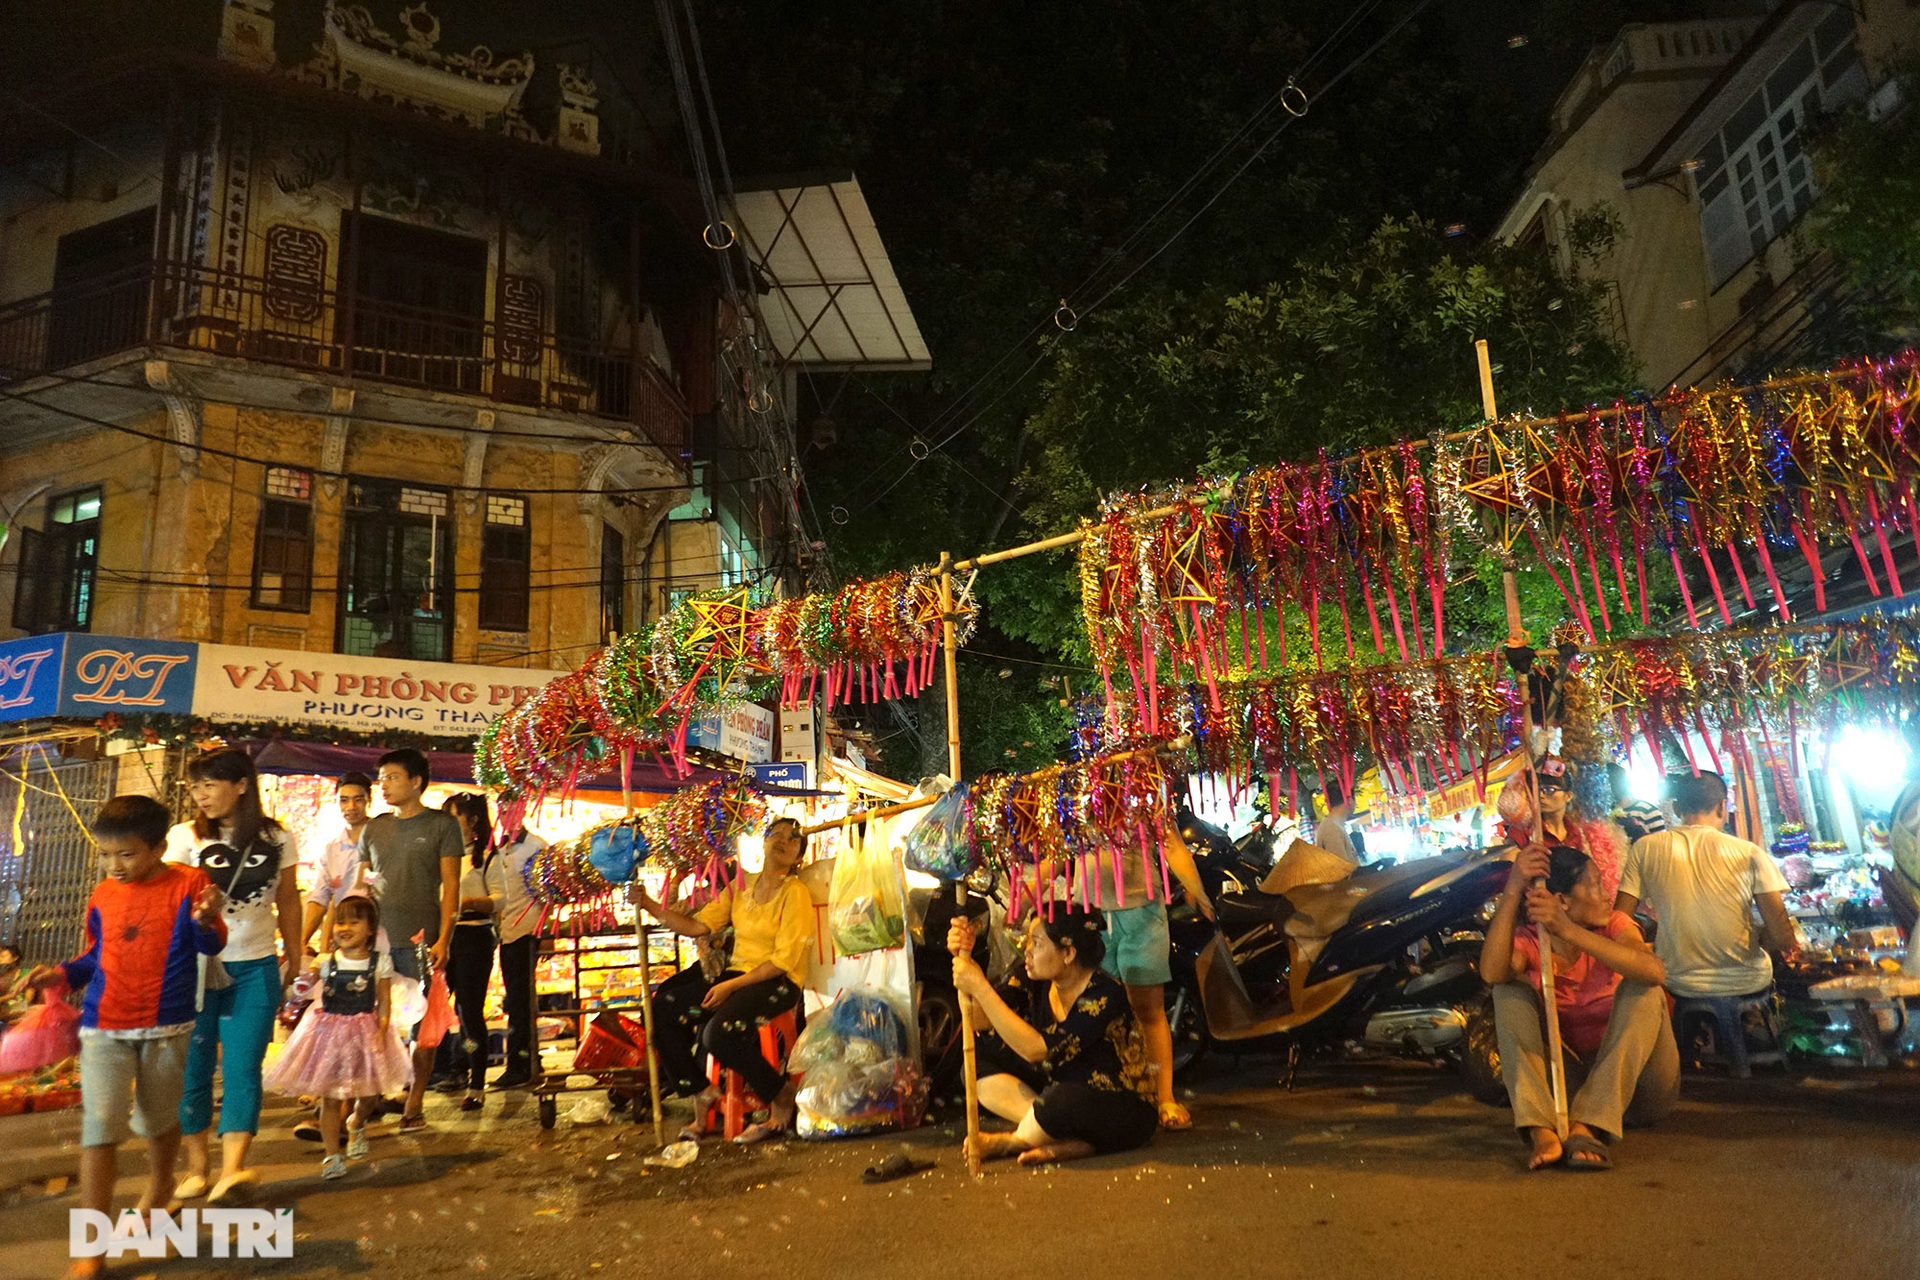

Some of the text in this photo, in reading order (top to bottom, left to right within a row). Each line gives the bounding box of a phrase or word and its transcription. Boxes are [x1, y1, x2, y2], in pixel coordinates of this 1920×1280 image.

[223, 660, 539, 706] VĂN PHÒNG PH
[304, 700, 505, 725] PHƯƠNG THAN
[768, 767, 789, 778] PHỐ
